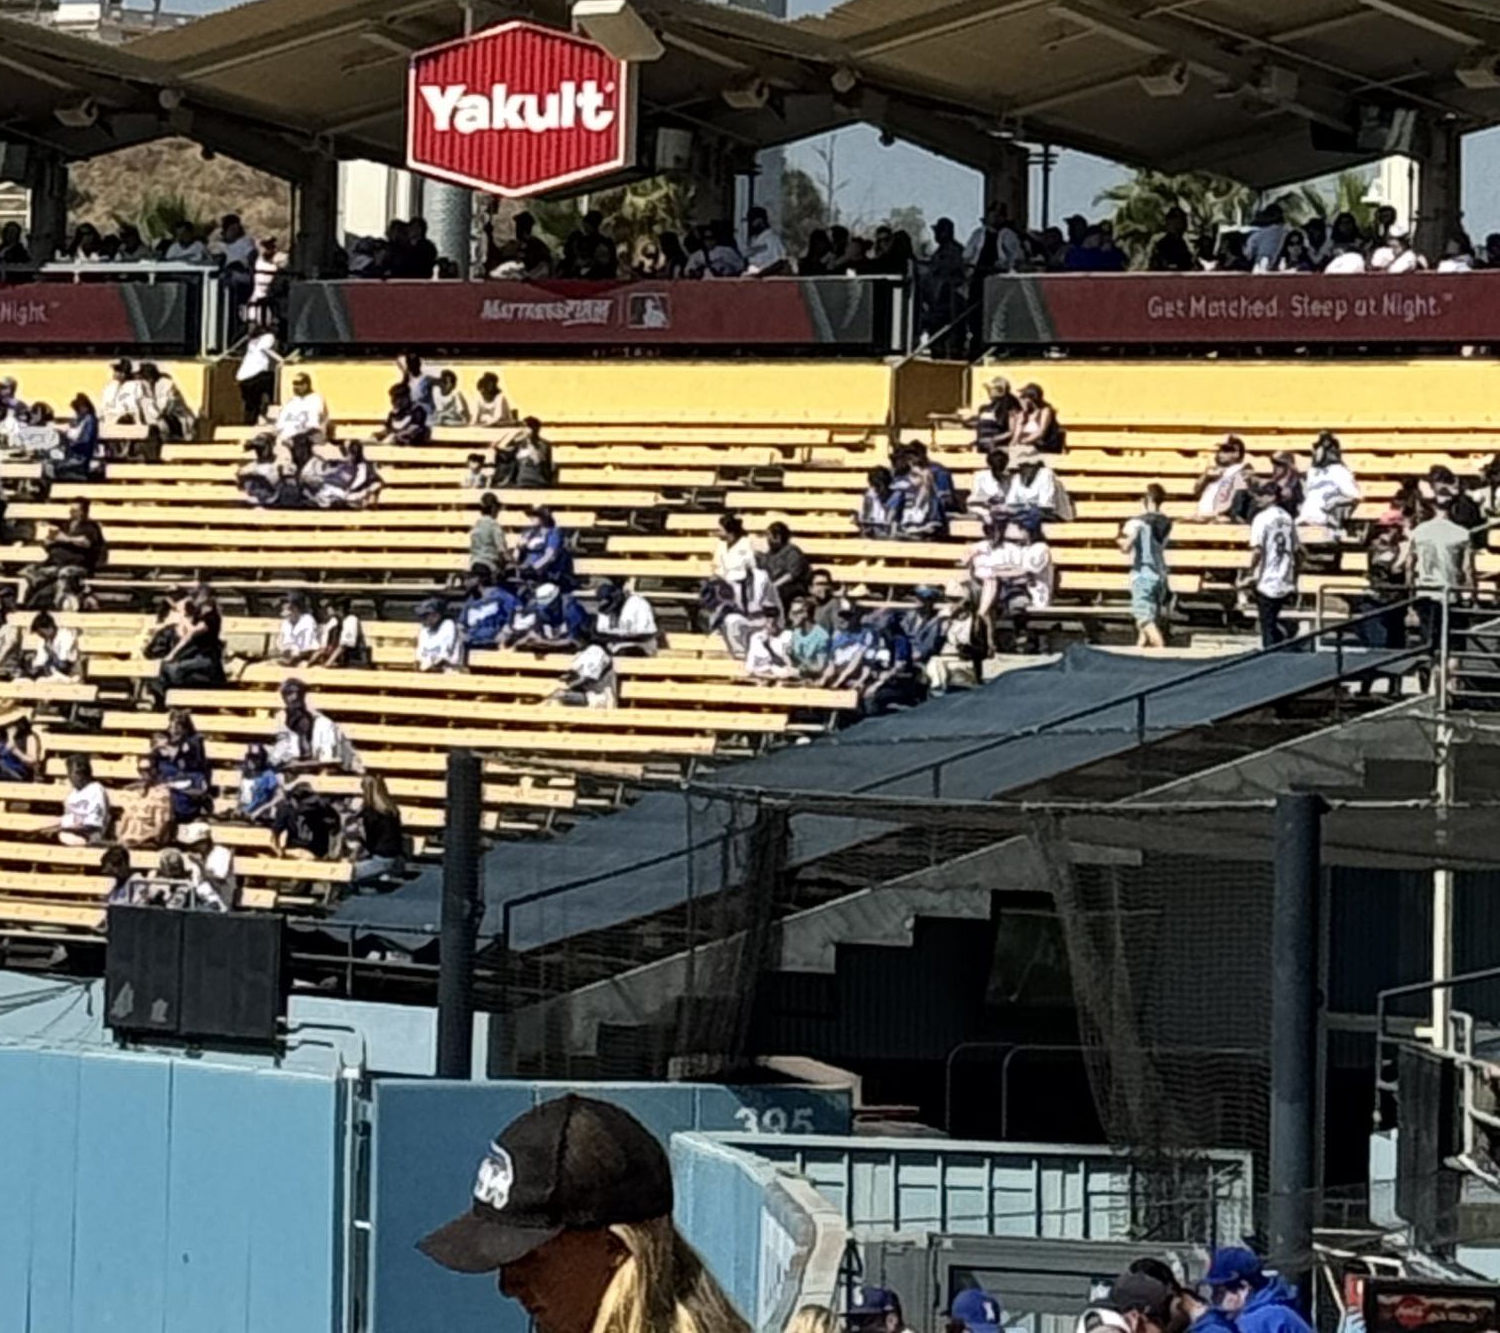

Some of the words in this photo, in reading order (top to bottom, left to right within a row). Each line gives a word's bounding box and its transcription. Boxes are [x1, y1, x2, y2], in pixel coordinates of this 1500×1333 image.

[420, 79, 615, 134] Yakult
[1148, 295, 1185, 318] Get
[1291, 293, 1348, 321] Sleep
